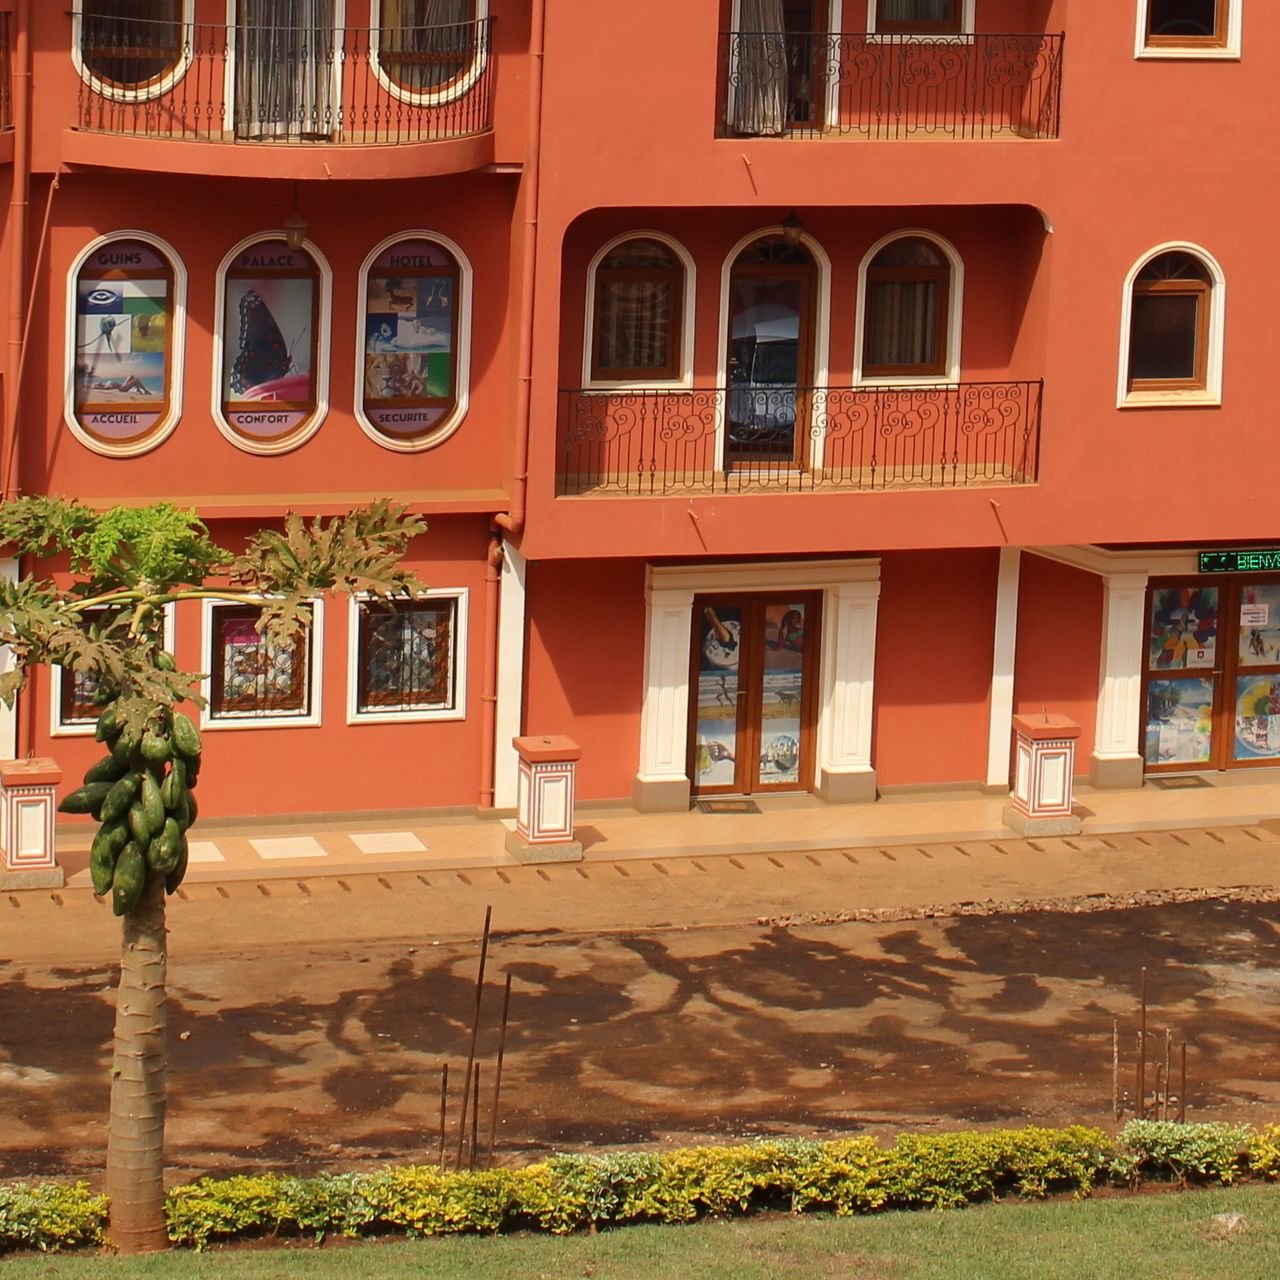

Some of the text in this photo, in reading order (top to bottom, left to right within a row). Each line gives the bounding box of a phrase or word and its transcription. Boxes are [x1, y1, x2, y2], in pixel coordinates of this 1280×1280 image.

[98, 252, 142, 265] GUINS
[242, 255, 294, 268] PALACE
[390, 255, 433, 268] HOTEL
[91, 414, 139, 424] ACCUEIL
[236, 414, 290, 424] CONFORT
